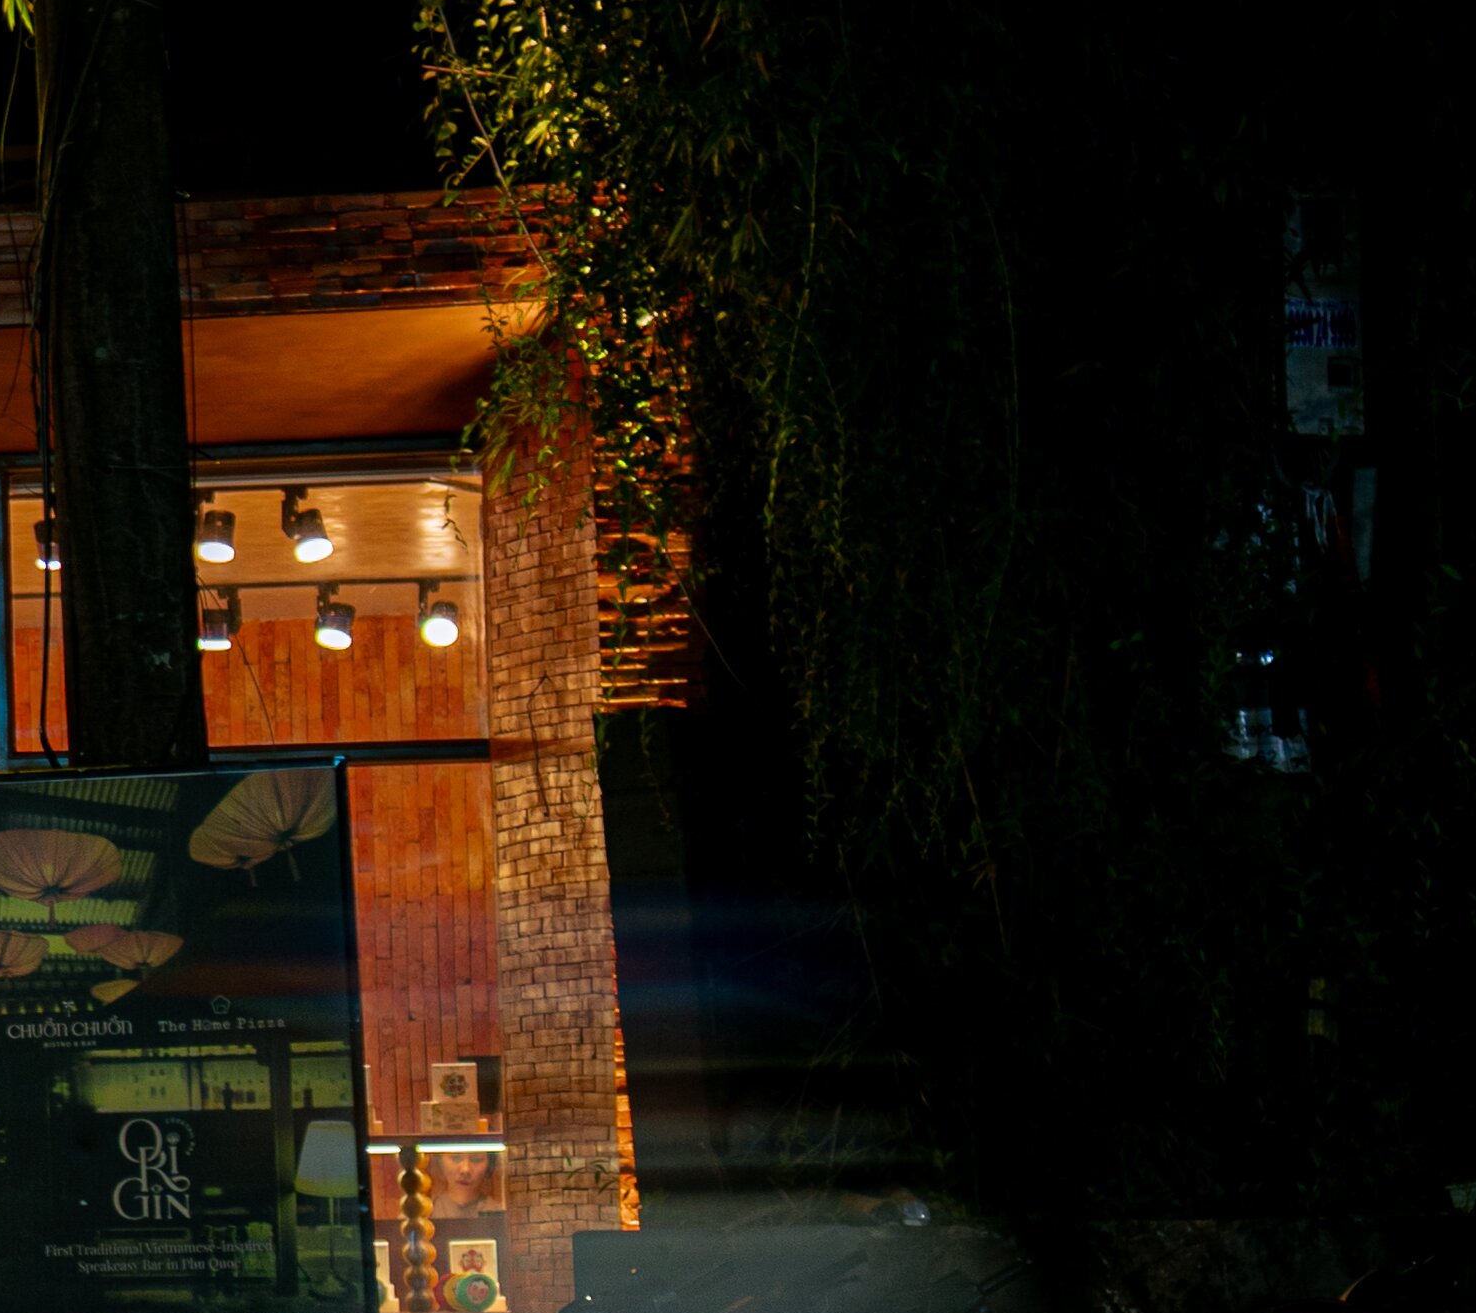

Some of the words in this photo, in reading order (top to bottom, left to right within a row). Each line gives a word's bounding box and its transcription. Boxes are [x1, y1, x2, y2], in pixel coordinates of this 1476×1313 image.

[158, 1020, 186, 1033] The
[236, 1016, 286, 1029] Pizza
[44, 1244, 73, 1256] First
[75, 1241, 142, 1256] Traditional
[77, 1259, 138, 1274] Speakeasy
[143, 1259, 163, 1271] Bar
[167, 1259, 179, 1270] in
